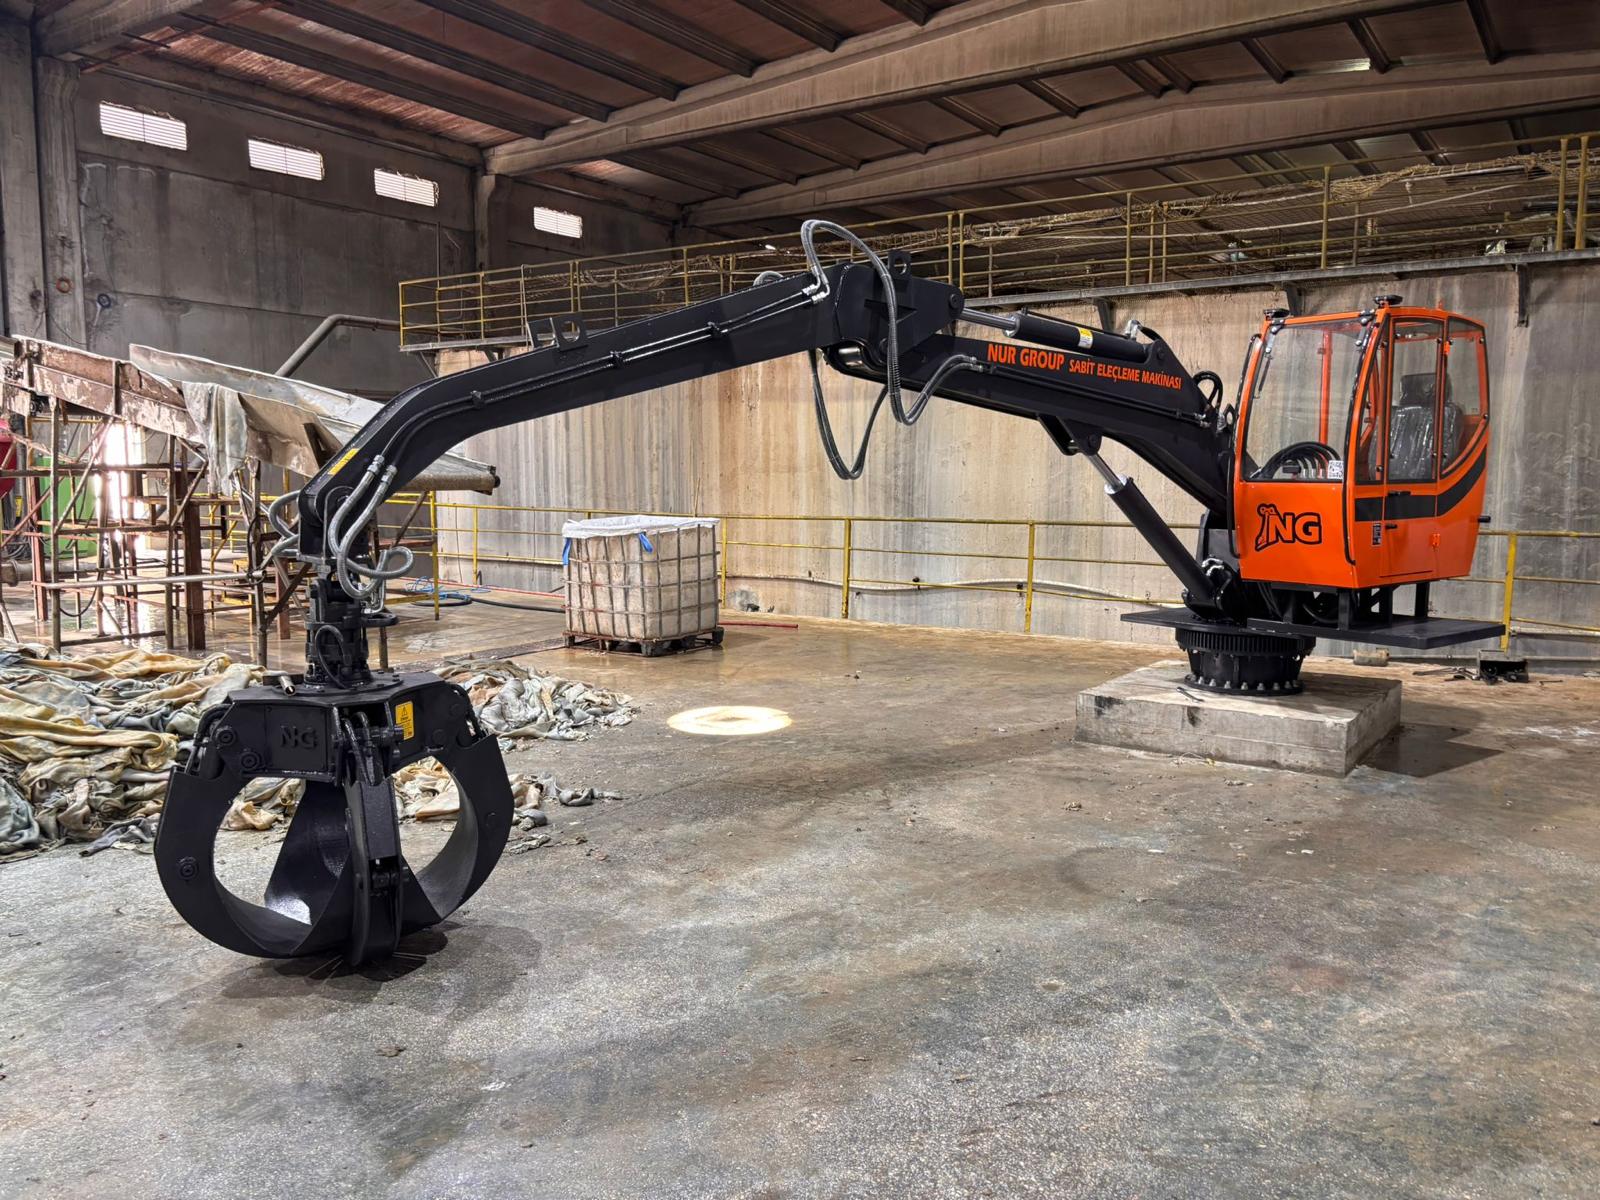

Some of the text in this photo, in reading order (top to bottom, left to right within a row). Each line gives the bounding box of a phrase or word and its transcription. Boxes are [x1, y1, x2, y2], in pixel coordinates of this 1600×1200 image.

[987, 343, 1017, 365] NUR
[1020, 348, 1065, 370] GROUP
[1069, 358, 1096, 375] SABİT
